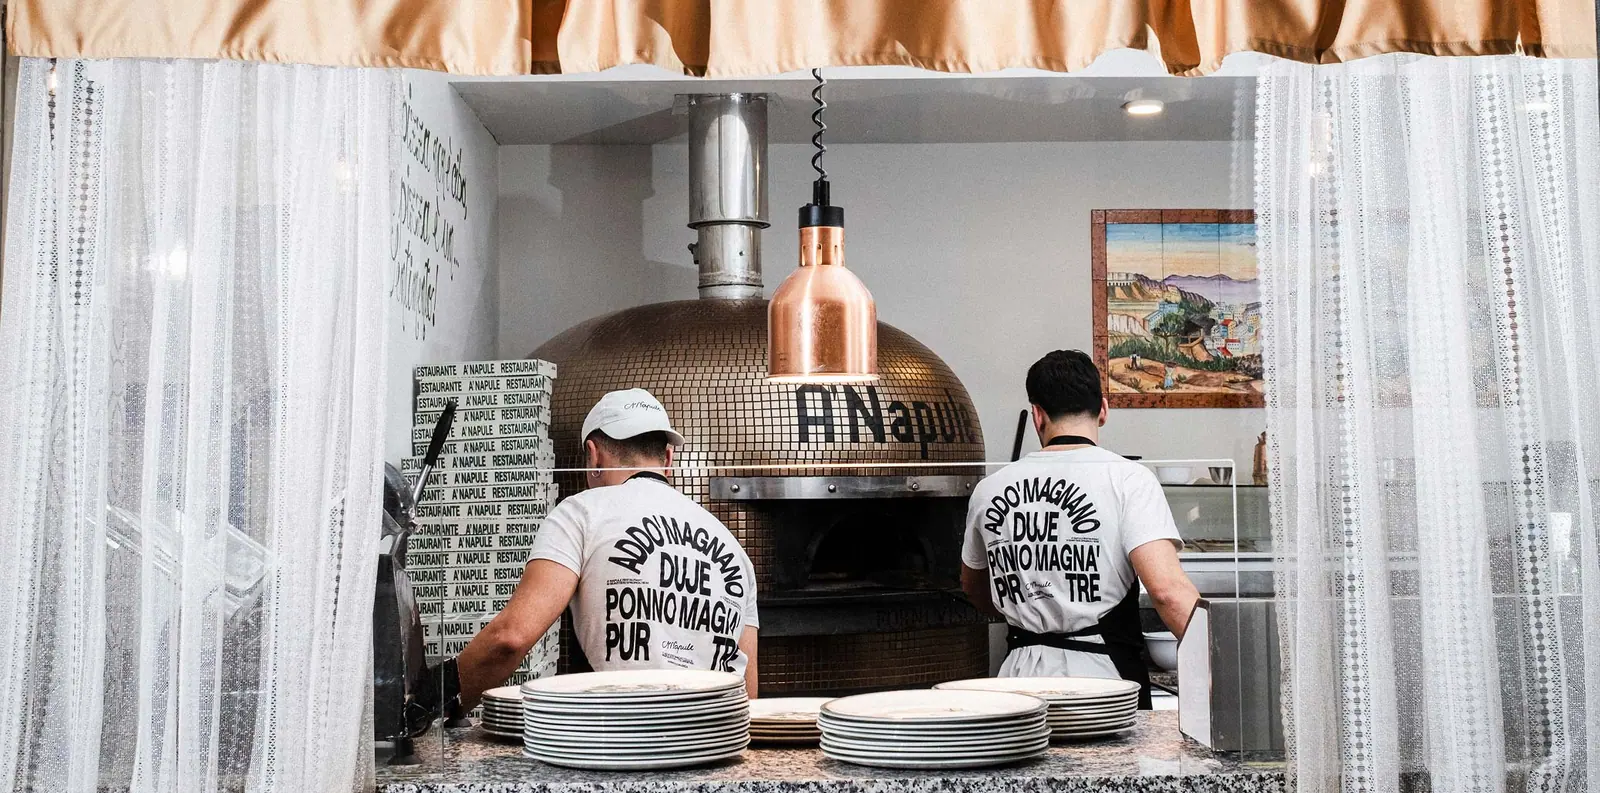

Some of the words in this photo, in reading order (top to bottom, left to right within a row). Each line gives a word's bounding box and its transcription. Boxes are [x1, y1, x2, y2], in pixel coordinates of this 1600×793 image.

[1023, 477, 1100, 534] MAGNANO
[1013, 511, 1059, 542] DUJE
[660, 551, 711, 597] DUJE
[1065, 573, 1102, 602] TRE
[605, 587, 677, 625] PONNO
[605, 622, 651, 662] PUR
[710, 635, 739, 672] TRE
